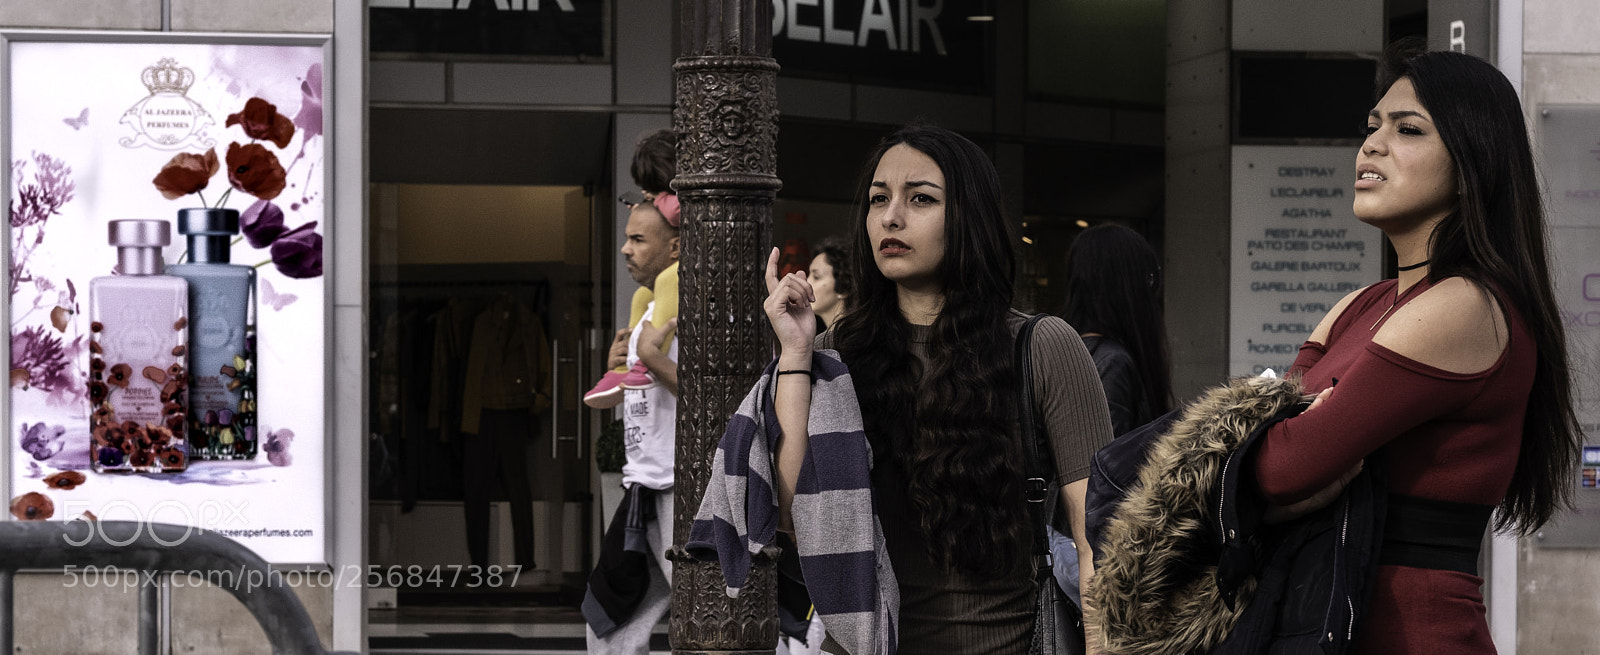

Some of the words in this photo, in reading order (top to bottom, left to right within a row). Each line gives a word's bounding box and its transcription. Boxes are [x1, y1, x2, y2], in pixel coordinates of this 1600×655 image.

[772, 0, 948, 56] ELAIR
[146, 121, 189, 129] PERFUMES
[1278, 167, 1336, 177] DESTRAY
[1281, 208, 1332, 218] AGATHA
[1265, 229, 1348, 239] RESTAURANT
[1247, 241, 1282, 251] PATIO
[1284, 241, 1309, 252] DES
[1311, 241, 1365, 252] CHAMPS
[1251, 261, 1299, 271] GALERIE
[1301, 261, 1361, 272] BARTOUX
[1250, 282, 1305, 292] GARELLA
[1307, 282, 1362, 292] GALLERY
[1281, 303, 1297, 313] DE
[1248, 344, 1293, 353] ROMEO
